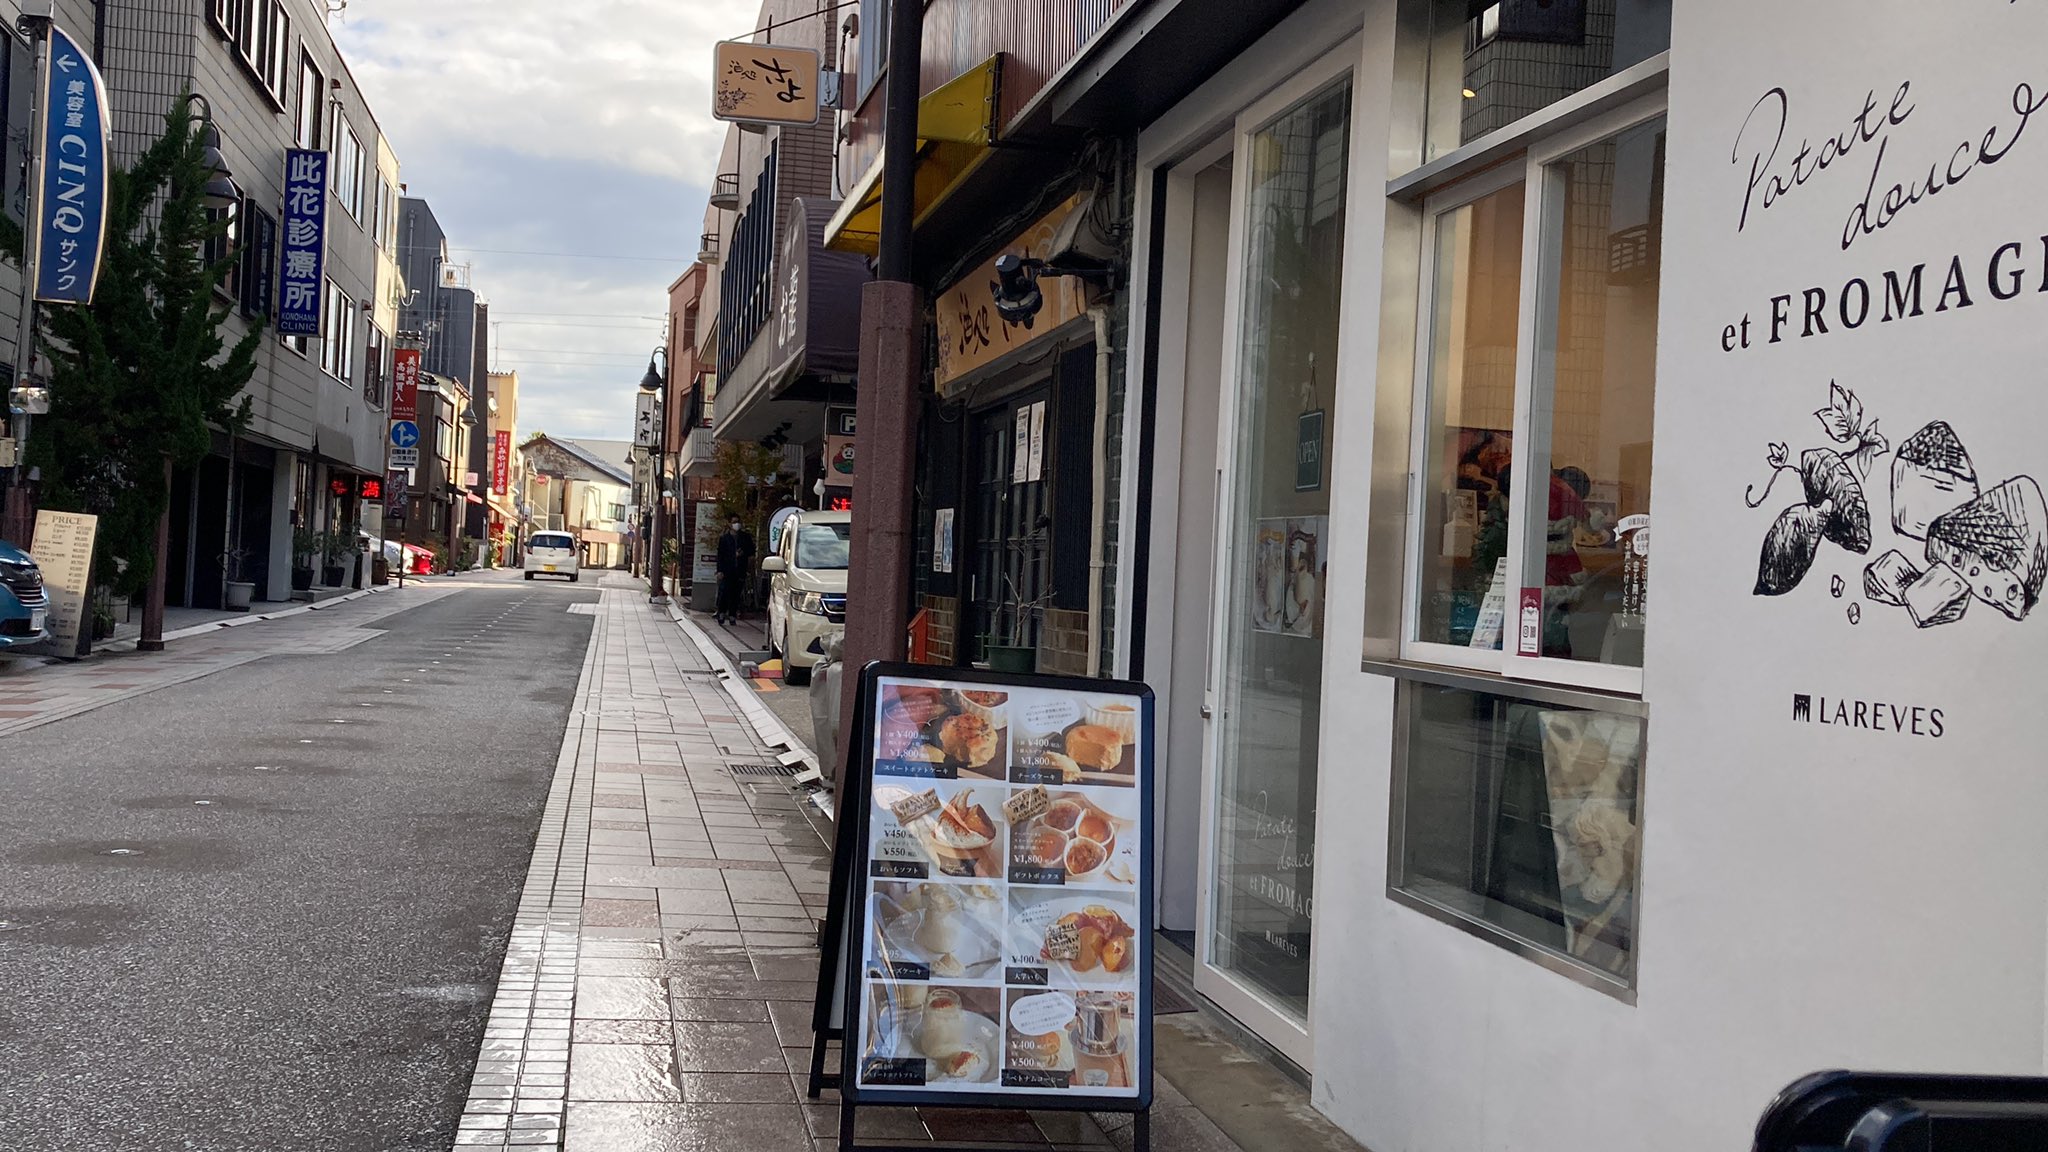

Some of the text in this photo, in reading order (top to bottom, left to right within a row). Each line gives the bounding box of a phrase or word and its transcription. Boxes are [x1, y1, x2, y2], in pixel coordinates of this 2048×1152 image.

[752, 57, 805, 104] さよ
[64, 80, 86, 128] 美容室
[1732, 80, 1916, 233] Patate
[1841, 82, 2048, 251] douce
[53, 134, 87, 234] CINQ
[283, 153, 321, 312] 此花診療所
[57, 238, 79, 291] サンク
[281, 312, 317, 322] KONOHANA
[280, 321, 316, 332] CLINIC
[1721, 312, 1751, 352] et
[406, 355, 416, 386] 美術品
[1299, 439, 1320, 466] OPEN
[362, 480, 380, 498] 満
[52, 515, 82, 525] PRICE
[1819, 697, 1945, 738] LAREVES
[1028, 738, 1049, 748] ¥400
[890, 748, 919, 759] ¥1,800
[1021, 756, 1050, 767] ¥1,800
[884, 765, 949, 775] スイートポテトケーキ
[1018, 773, 1056, 782] チーズケーキ
[884, 829, 907, 839] ¥450
[884, 848, 906, 857] ¥550
[1013, 854, 1043, 865] ¥1,800
[879, 866, 918, 875] おいもソフト
[1014, 871, 1060, 881] ギフトボックス
[1271, 936, 1298, 958] LAREVES
[1011, 1057, 1035, 1067] ¥500
[1010, 1074, 1064, 1083] ベトナムコーヒー
